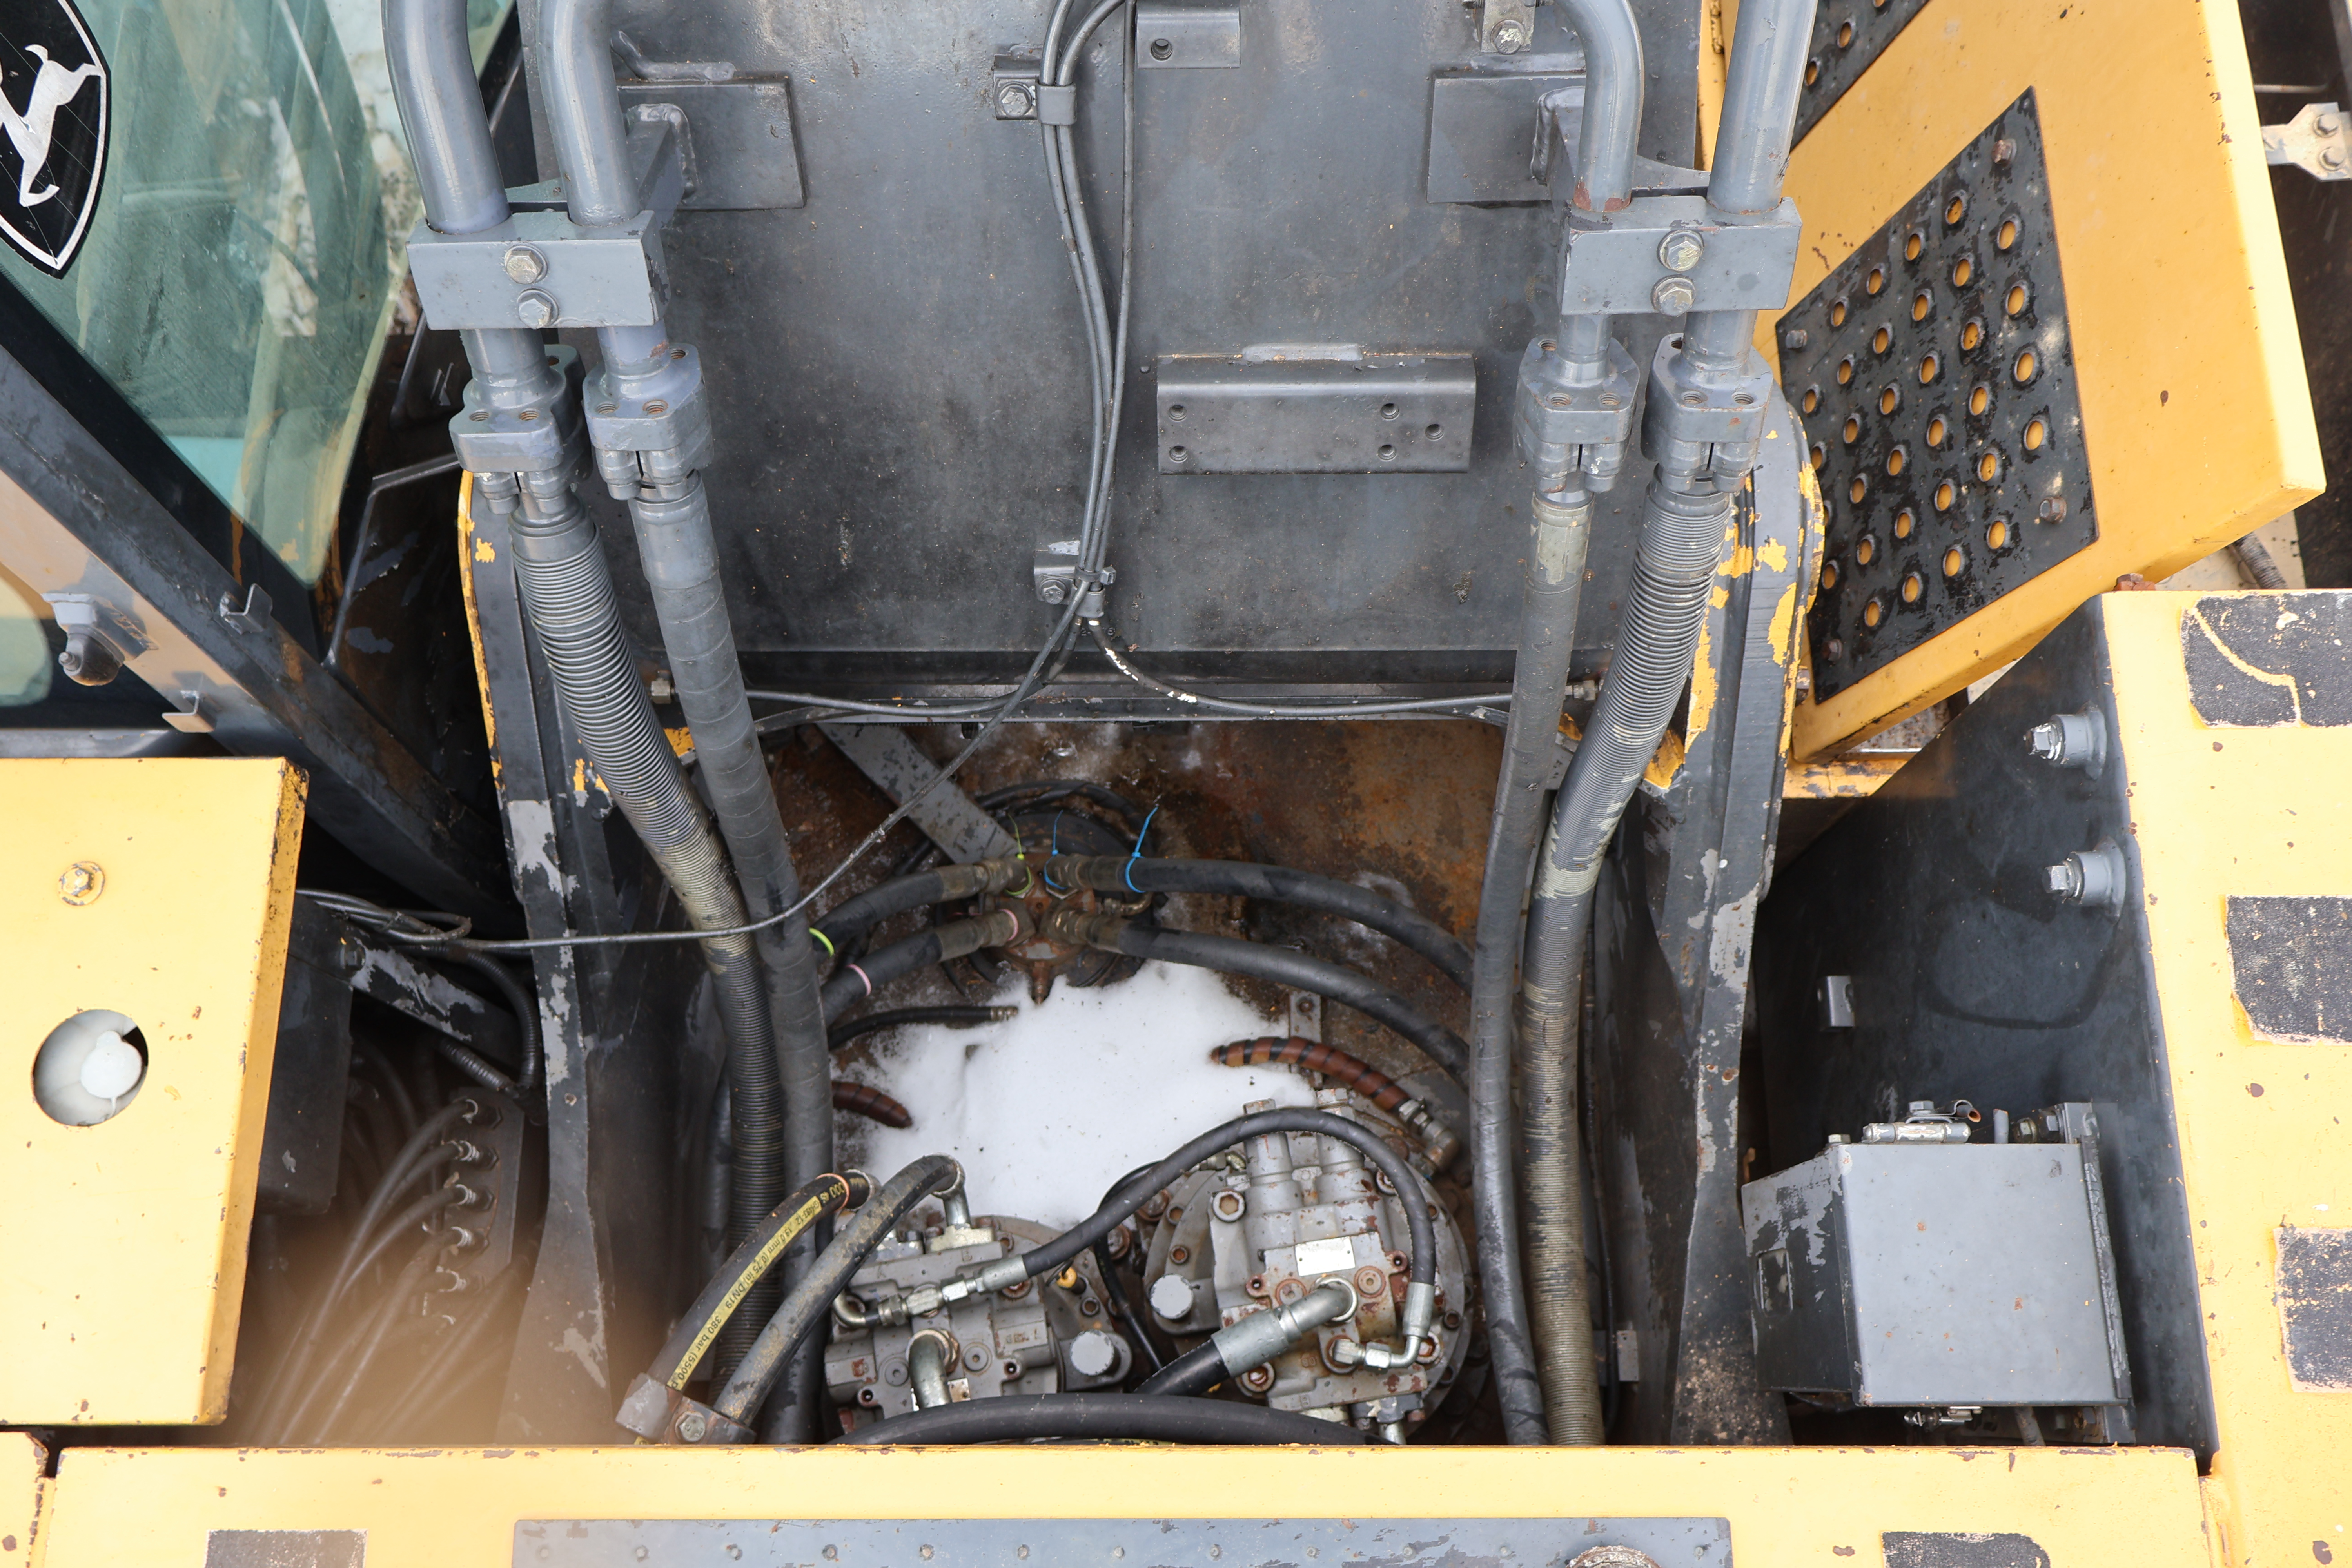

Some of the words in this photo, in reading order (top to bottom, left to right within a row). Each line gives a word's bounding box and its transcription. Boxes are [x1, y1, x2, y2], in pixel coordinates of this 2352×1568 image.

[725, 1283, 745, 1309] DN19
[708, 1315, 722, 1334] 380
[696, 1334, 710, 1351] bar
[677, 1351, 698, 1381] (5500
